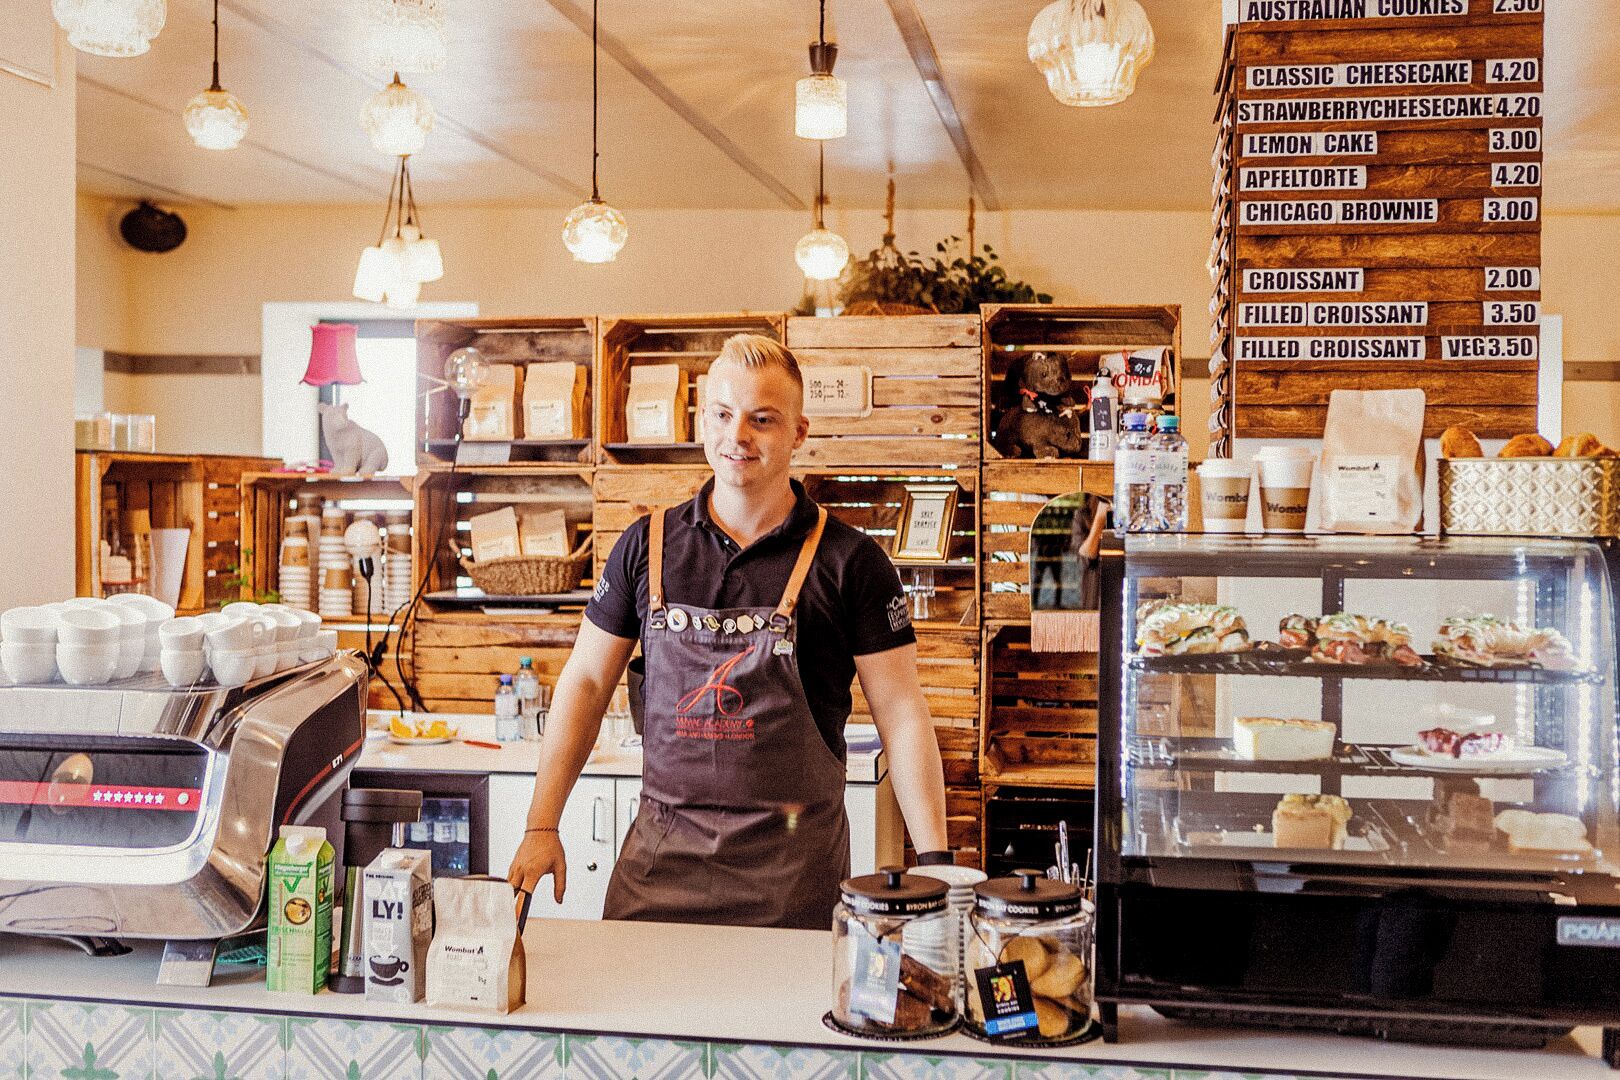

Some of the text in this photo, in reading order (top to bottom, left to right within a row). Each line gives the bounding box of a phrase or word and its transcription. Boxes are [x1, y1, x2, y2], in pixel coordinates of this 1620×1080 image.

[1247, 0, 1366, 20] AUSTRALIAN
[1378, 0, 1463, 16] COOKIES
[1252, 61, 1537, 86] CLASSIC CHEESECAKE 4.20
[1496, 97, 1540, 118] 4.20
[1248, 130, 1537, 154] LEMON CAKE 3.00
[1245, 165, 1539, 188] APFELTORTE 4.20
[1246, 201, 1533, 221] CHICAGO BROWNIE 3.00
[1249, 269, 1533, 290] CROISSANT 2.00
[1244, 304, 1536, 324] FILLED CROISSANT 3.50
[1241, 338, 1533, 359] FILLED CROISSANT VEG 3.50
[372, 899, 404, 920] LY!
